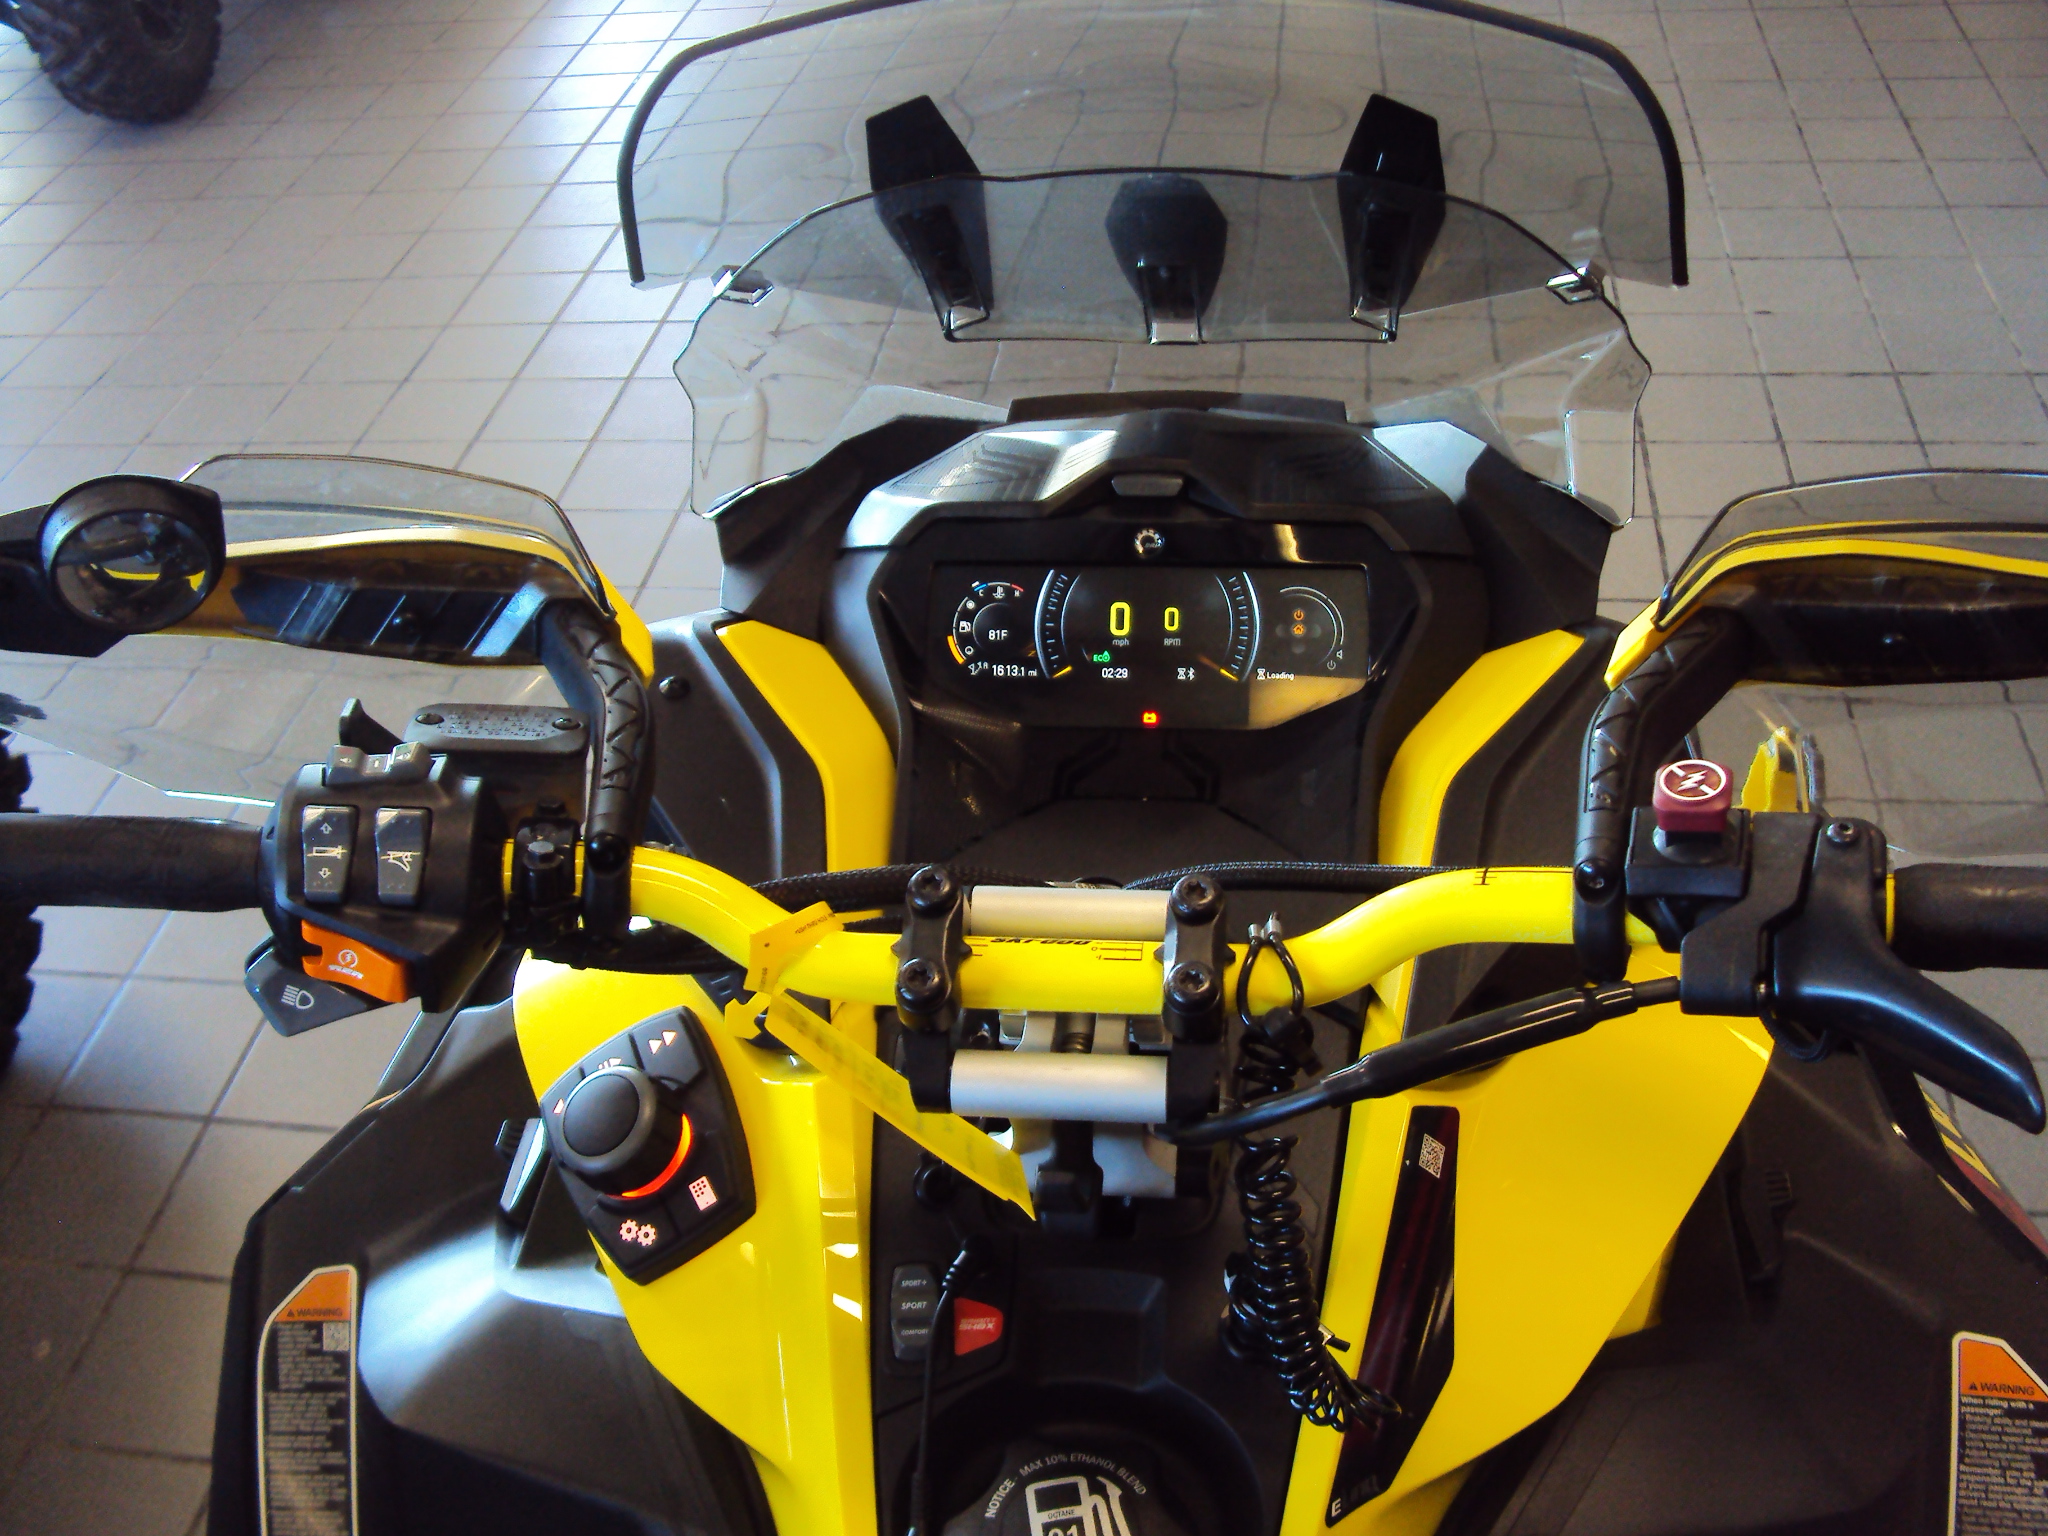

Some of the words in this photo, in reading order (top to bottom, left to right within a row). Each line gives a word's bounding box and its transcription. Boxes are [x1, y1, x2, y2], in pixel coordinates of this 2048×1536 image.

[1110, 602, 1130, 636] 0
[1164, 607, 1179, 631] 0
[988, 629, 1008, 641] 81F
[1112, 638, 1130, 648] mph
[1163, 638, 1181, 646] RPM
[992, 664, 1025, 677] 1613.1
[1027, 669, 1038, 677] mi
[1101, 667, 1129, 679] 02:29
[1266, 671, 1295, 681] Loading
[901, 1301, 928, 1310] SPORT
[297, 1307, 343, 1317] WARNING
[901, 1328, 929, 1336] COMFORT
[1980, 1383, 2035, 1395] WARNING
[984, 1478, 1016, 1519] NOTICE
[1019, 1459, 1044, 1477] MAX
[1046, 1453, 1068, 1466] 10%
[1070, 1452, 1116, 1472] ETHANOL
[1116, 1466, 1147, 1495] BLEND
[1331, 1497, 1341, 1517] E
[1047, 1508, 1076, 1520] OCTANE
